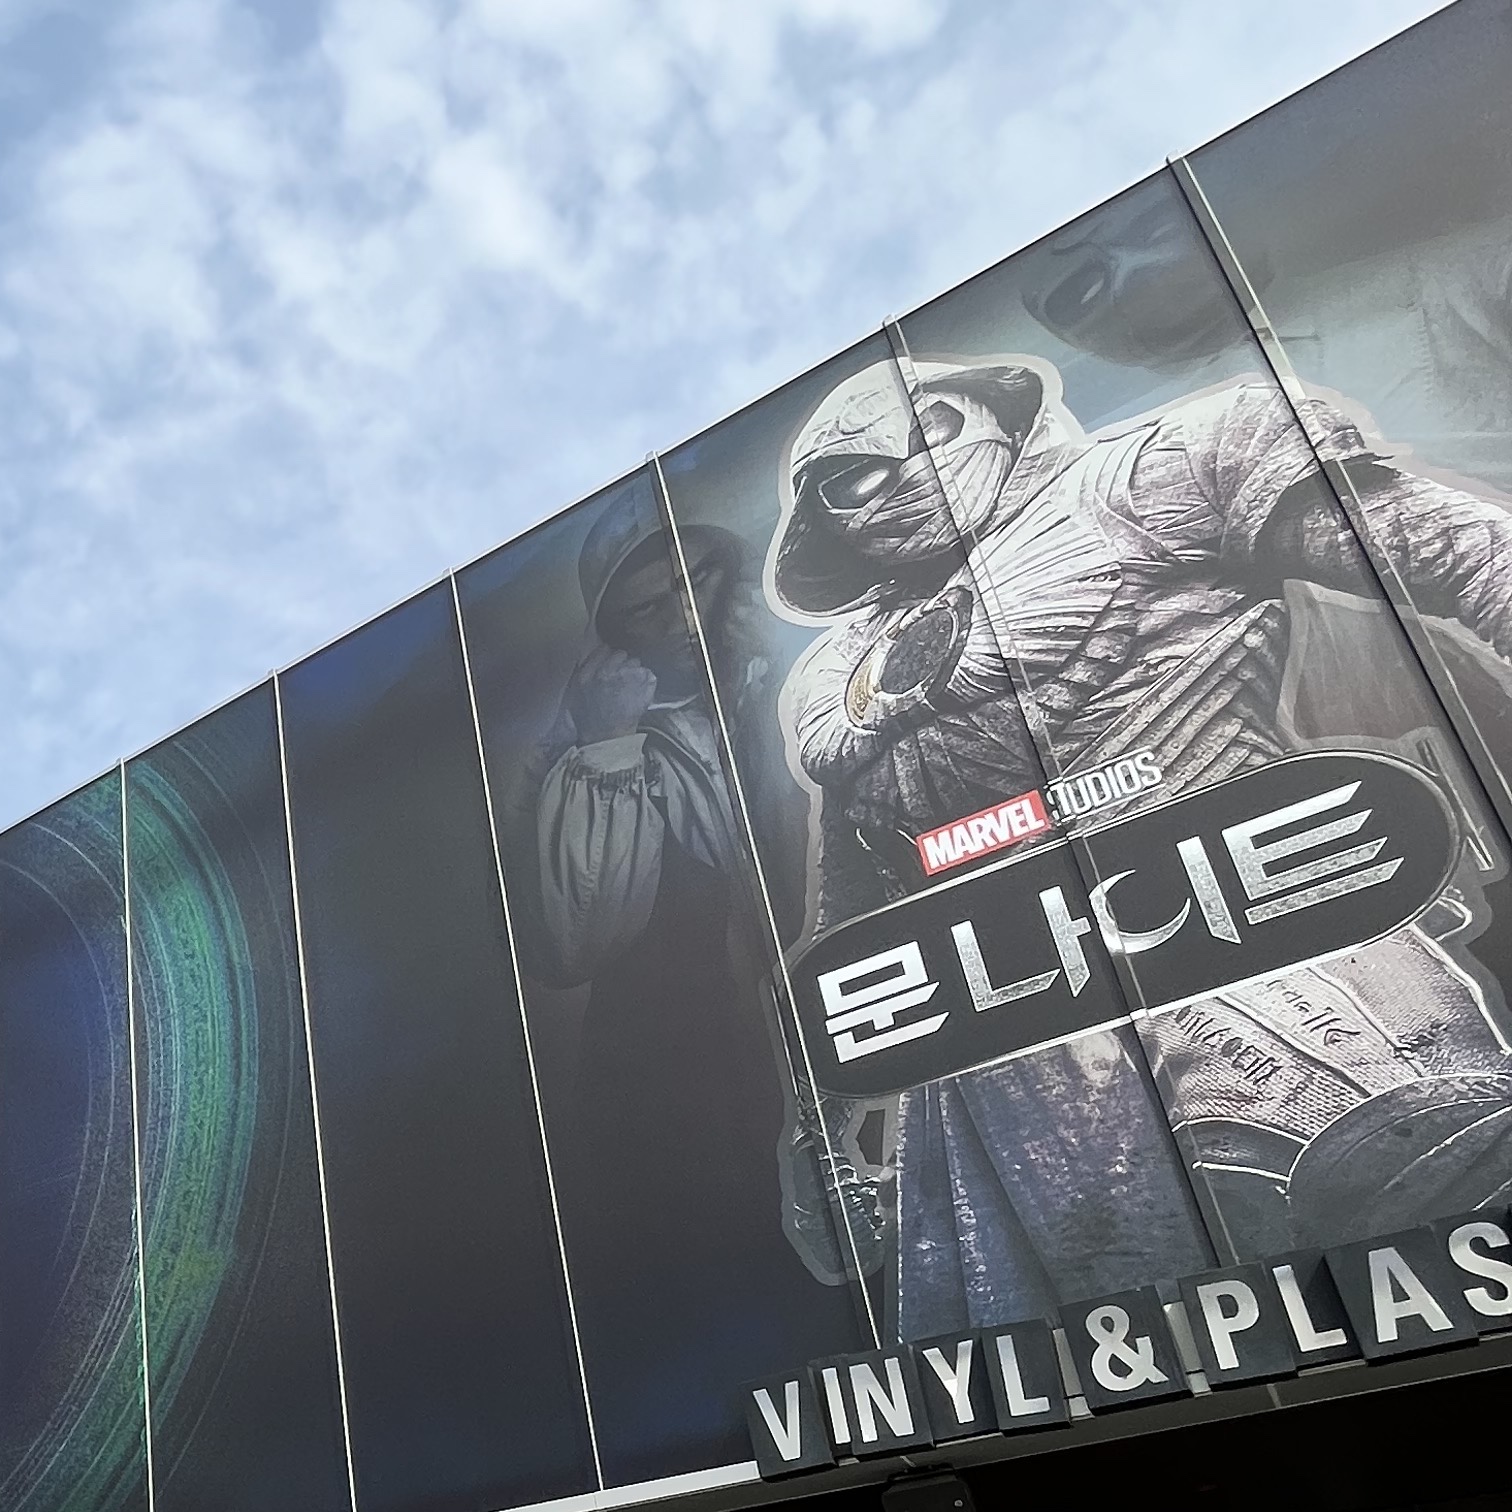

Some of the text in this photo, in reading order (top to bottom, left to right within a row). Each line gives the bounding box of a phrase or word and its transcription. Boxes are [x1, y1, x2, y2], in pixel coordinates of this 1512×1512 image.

[816, 779, 1405, 1065] 문나이트
[922, 798, 1046, 870] MARVEL
[752, 1221, 1512, 1462] VINYL & PLAS
